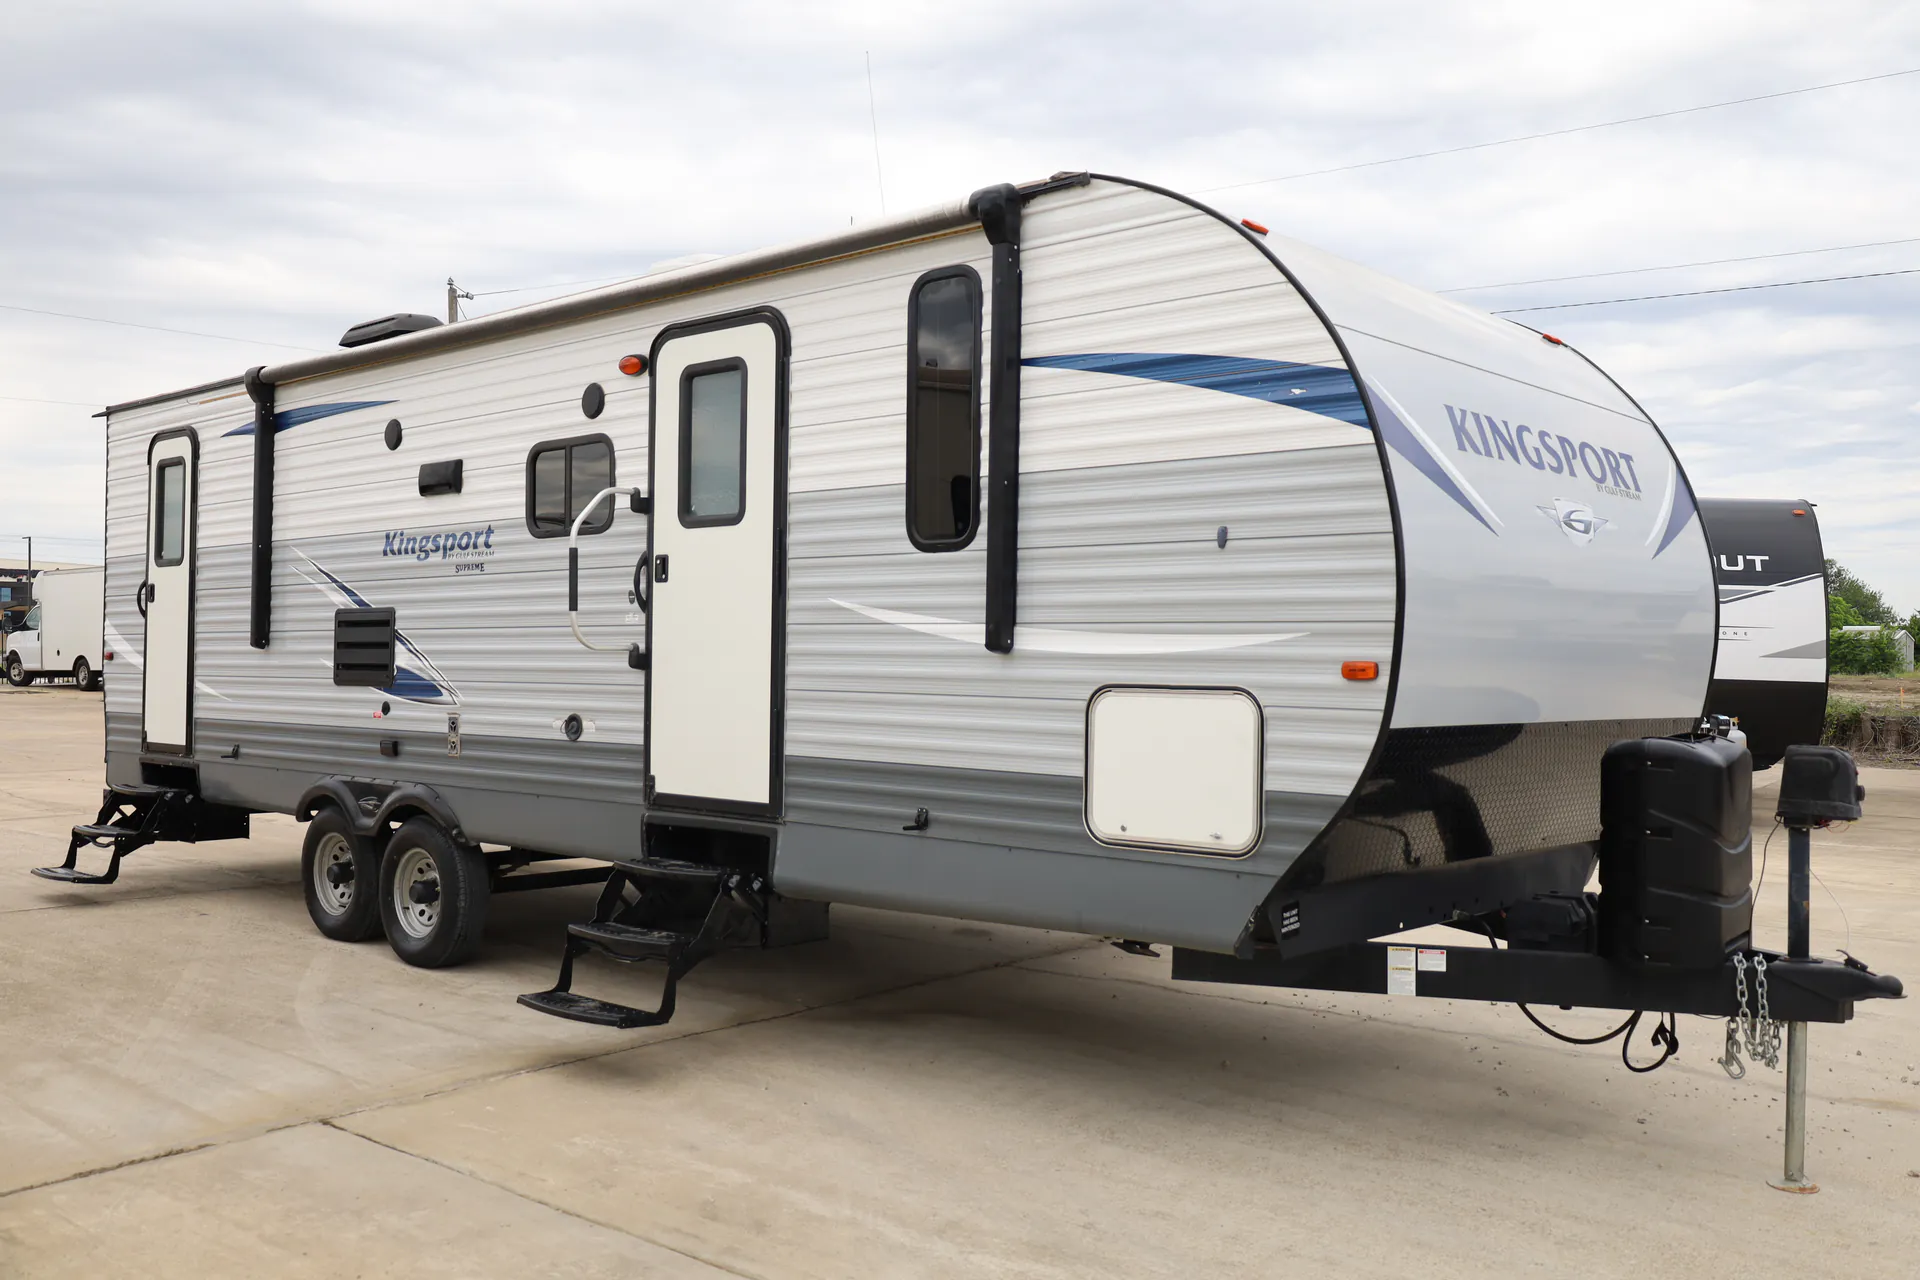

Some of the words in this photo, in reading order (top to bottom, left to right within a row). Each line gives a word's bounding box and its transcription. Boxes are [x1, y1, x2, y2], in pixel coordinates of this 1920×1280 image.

[1443, 404, 1642, 492] KINGSPORT
[383, 524, 495, 561] Kingsport
[455, 562, 485, 573] SUPREME
[1713, 554, 1769, 571] UT
